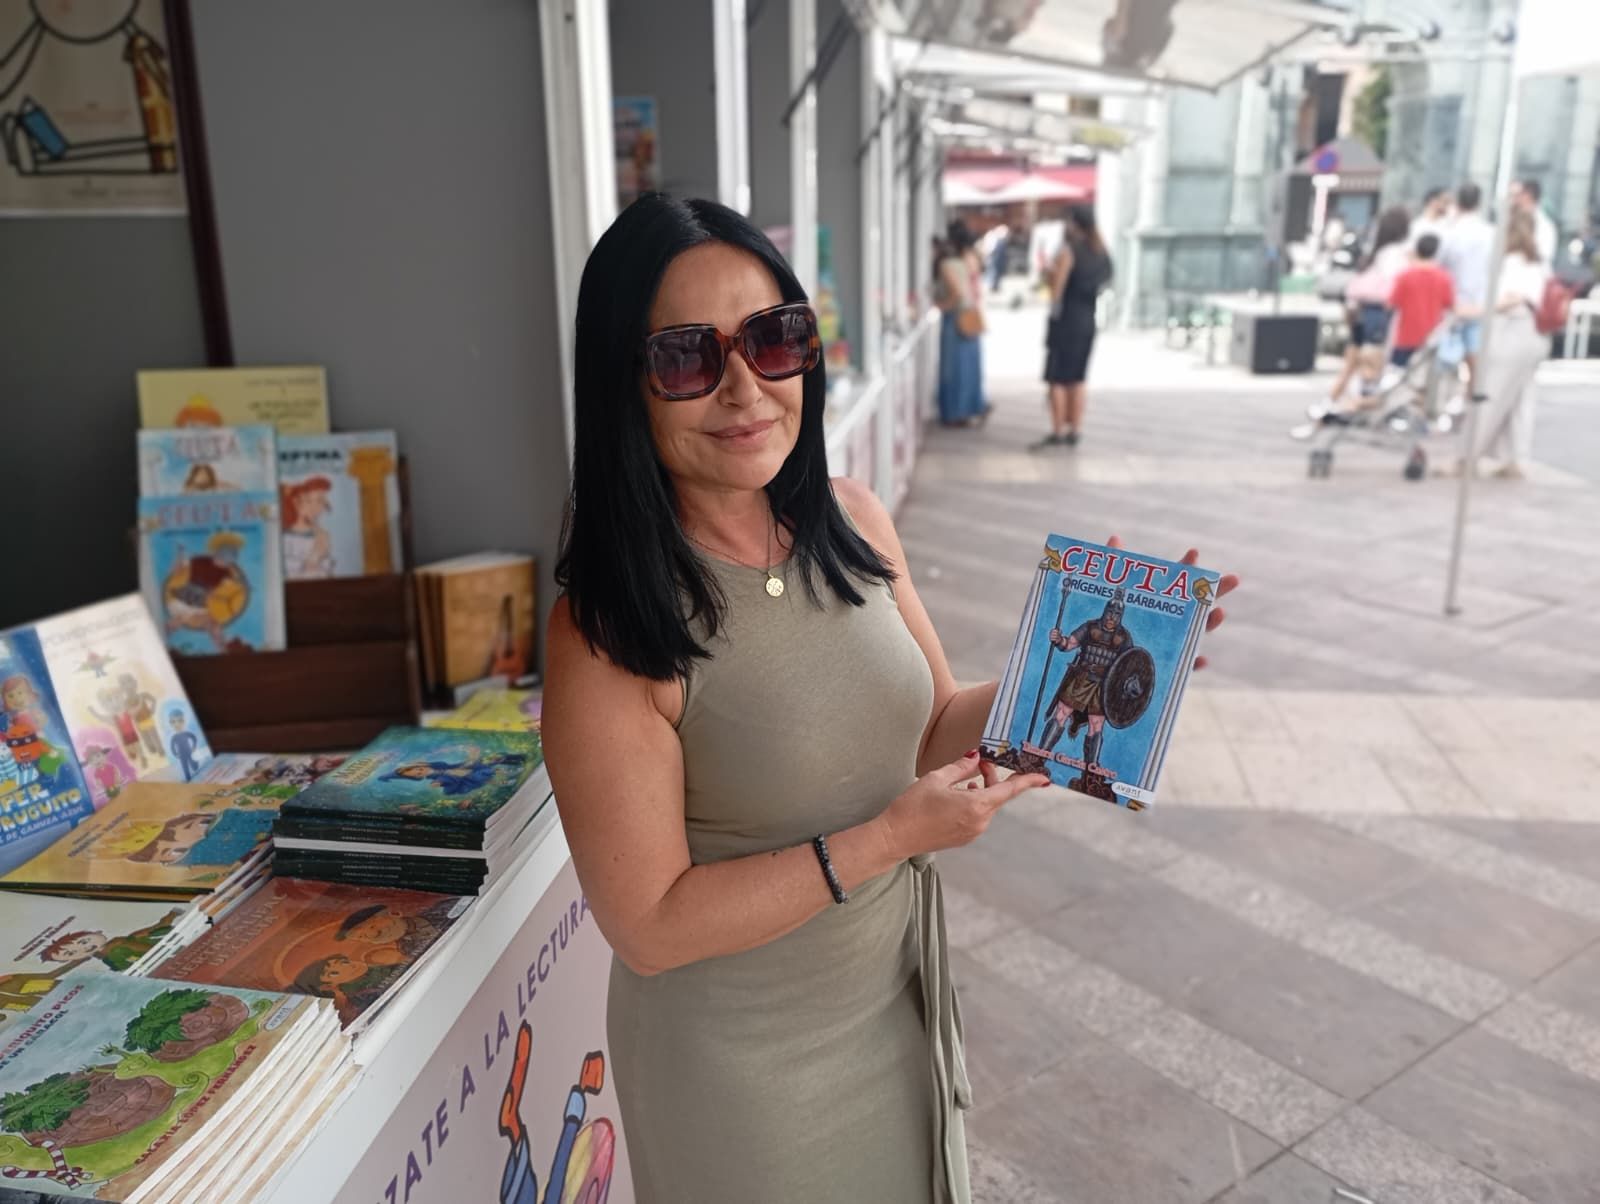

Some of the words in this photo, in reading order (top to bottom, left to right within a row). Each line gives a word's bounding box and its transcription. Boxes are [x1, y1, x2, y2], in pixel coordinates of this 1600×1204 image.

[1061, 545, 1191, 601] CEUTA
[1062, 576, 1113, 599] ORÍGENES
[1126, 591, 1186, 617] BÁRBAROS
[377, 1097, 450, 1204] ZATE
[459, 1063, 477, 1113] A
[484, 1010, 511, 1070] LA
[516, 893, 593, 1019] LECTURA
